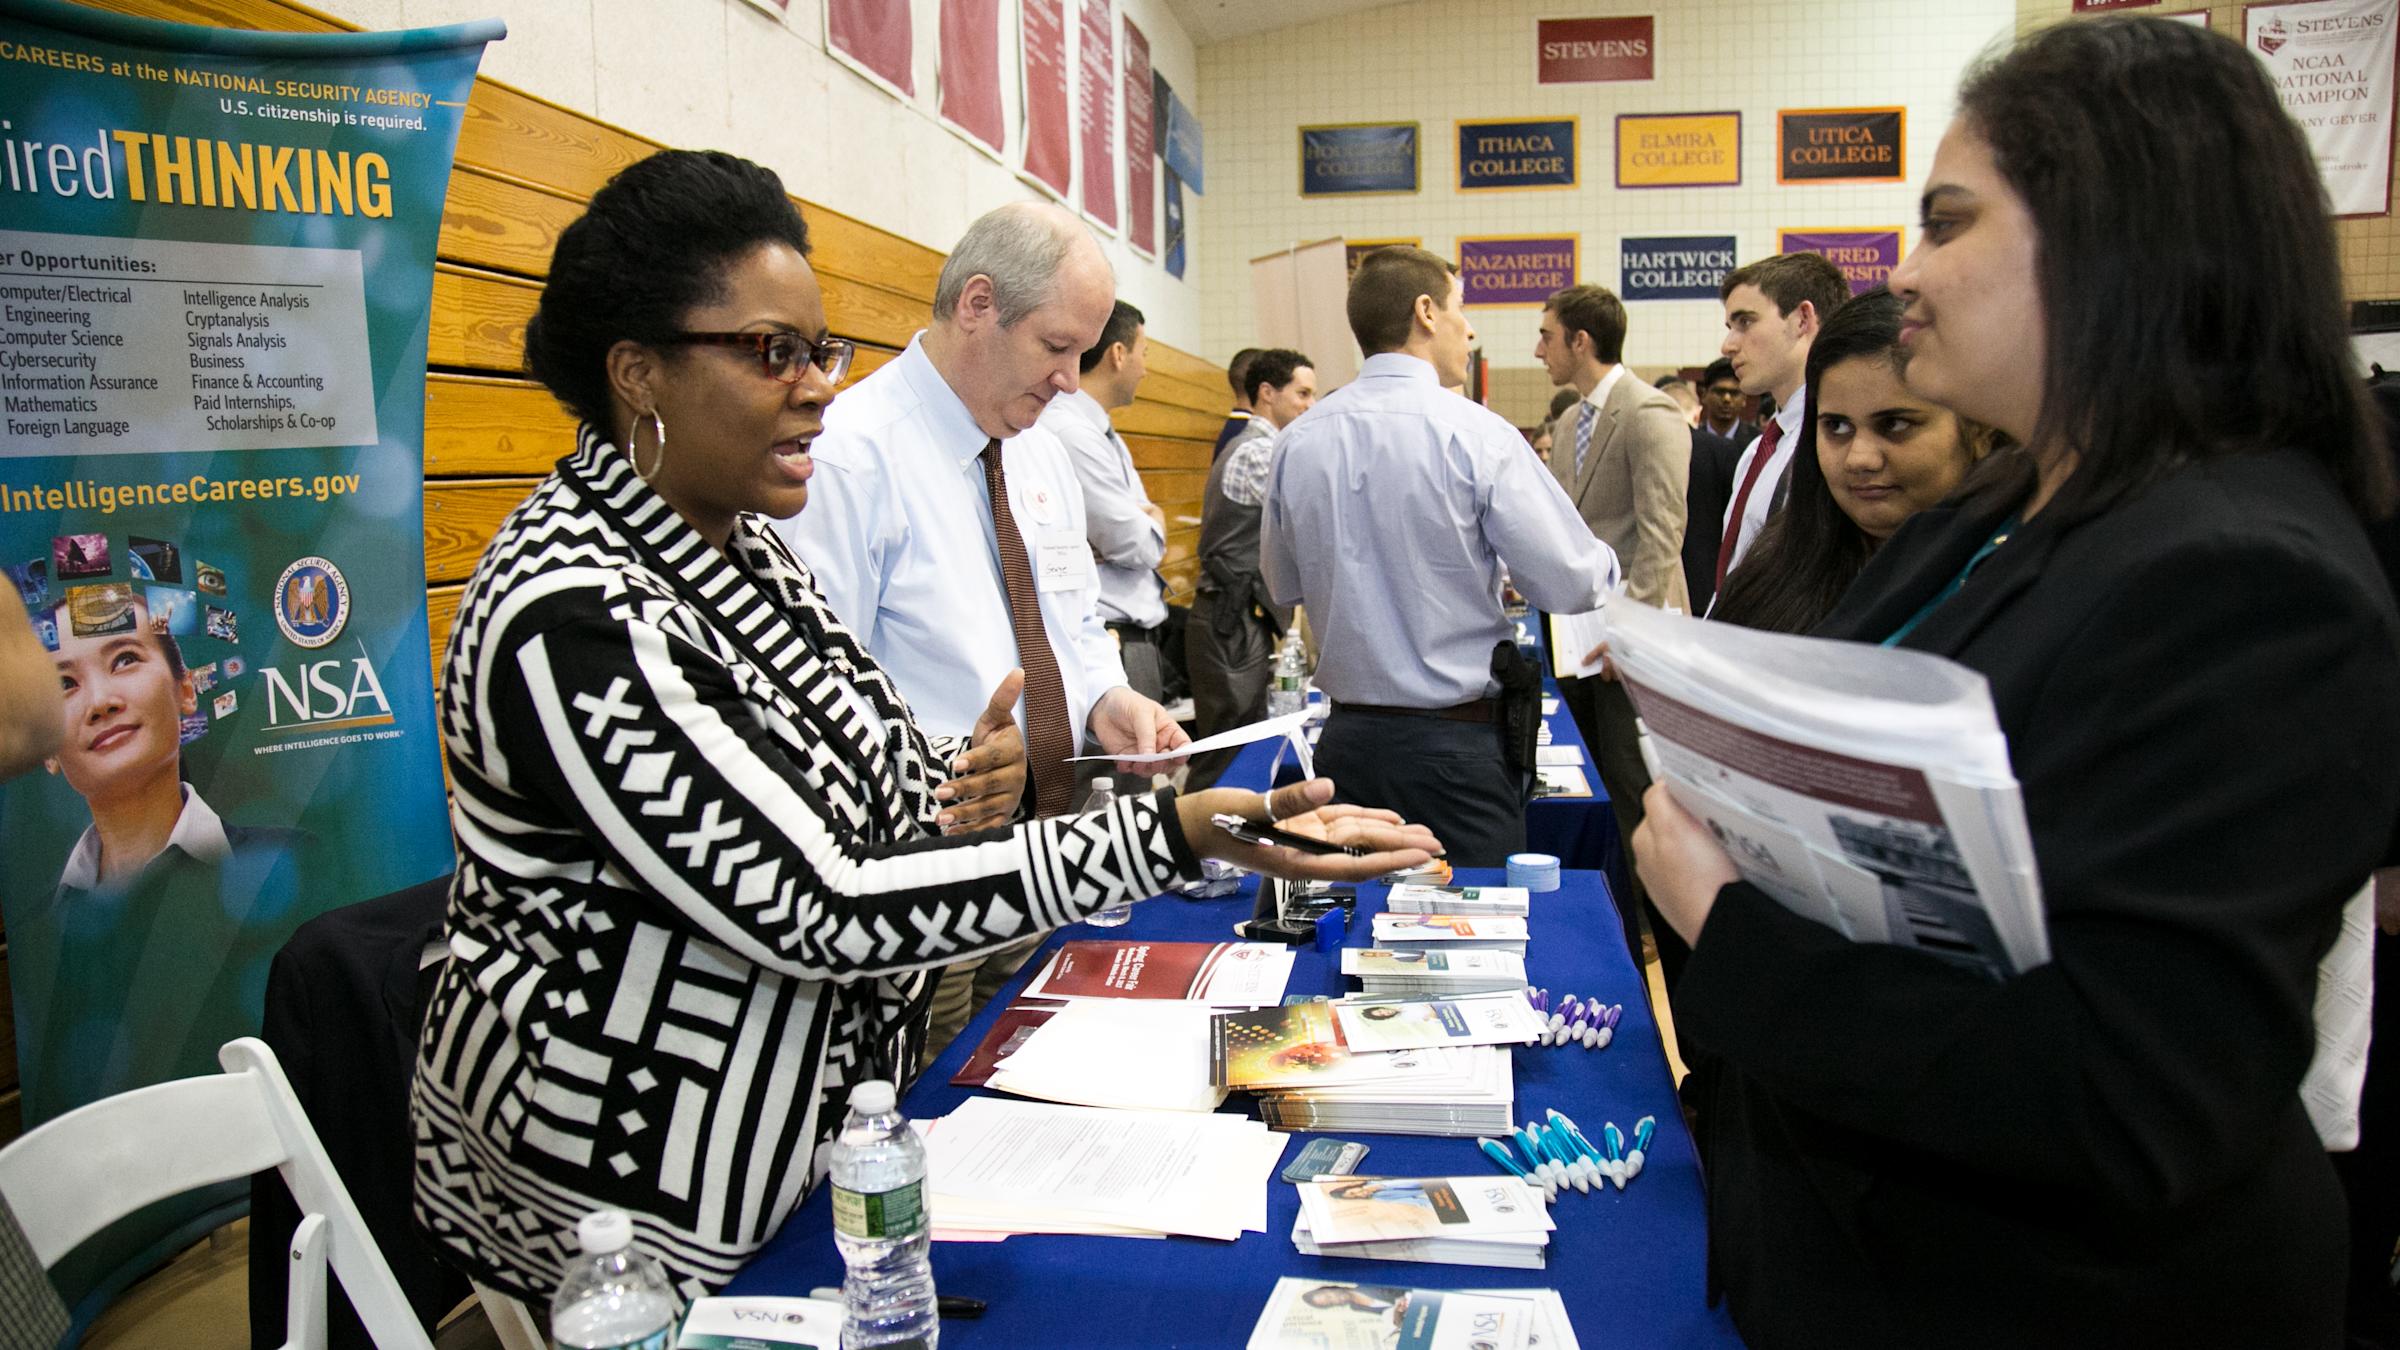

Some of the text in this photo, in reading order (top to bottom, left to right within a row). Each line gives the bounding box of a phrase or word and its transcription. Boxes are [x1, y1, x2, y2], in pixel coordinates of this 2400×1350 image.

[2296, 14, 2384, 34] STEVENS
[1544, 39, 1648, 60] STEVENS
[2292, 54, 2345, 71] NCAA
[0, 41, 432, 109] CAREERS at the NATIONAL SECURITY AGENCY
[2280, 87, 2369, 106] HAMPION
[220, 98, 428, 132] U.S. citizenship is required.
[2330, 113, 2377, 126] GEYER
[1477, 135, 1555, 154] ITHACA
[1640, 131, 1717, 150] ELMIRA
[1808, 126, 1874, 145] UTICA
[1630, 148, 1725, 168] COLLEGE
[1790, 144, 1892, 164] COLLEGE
[1468, 156, 1566, 177] COLLEGE
[21, 250, 157, 273] Opportunities:
[1463, 252, 1572, 272] NAZARETH
[1623, 250, 1734, 270] HARTWICK
[1816, 247, 1880, 264] FRED
[1471, 270, 1564, 290] COLLEGE
[1630, 269, 1725, 288] COLLEGE
[183, 290, 310, 311] Intelligence Analysis
[5, 305, 92, 327] Engineering
[186, 311, 270, 331] Cryptanalysis
[71, 330, 124, 347] Science
[187, 332, 287, 351] Signals Analysis
[0, 351, 97, 371] Cybersecurity
[190, 353, 245, 369] Business
[2, 373, 159, 391] Information Assurance
[192, 374, 325, 391] Finance & Accounting
[5, 396, 98, 413] Mathematics
[194, 394, 296, 411] Paid Internships,
[8, 418, 130, 438] Foreign Language
[207, 413, 336, 432] Scholarships & Co-op
[0, 474, 362, 515] IntelligenceCareers.gov
[296, 558, 331, 572] SECURITY
[329, 570, 349, 607] AGENCY
[258, 642, 394, 725] NSA
[254, 744, 284, 755] WHERE
[284, 735, 340, 751] INTELLIGENCE
[340, 733, 362, 744] GOES
[363, 732, 375, 741] TO
[733, 1309, 778, 1323] NSA
[1471, 1312, 1500, 1336] NSA
